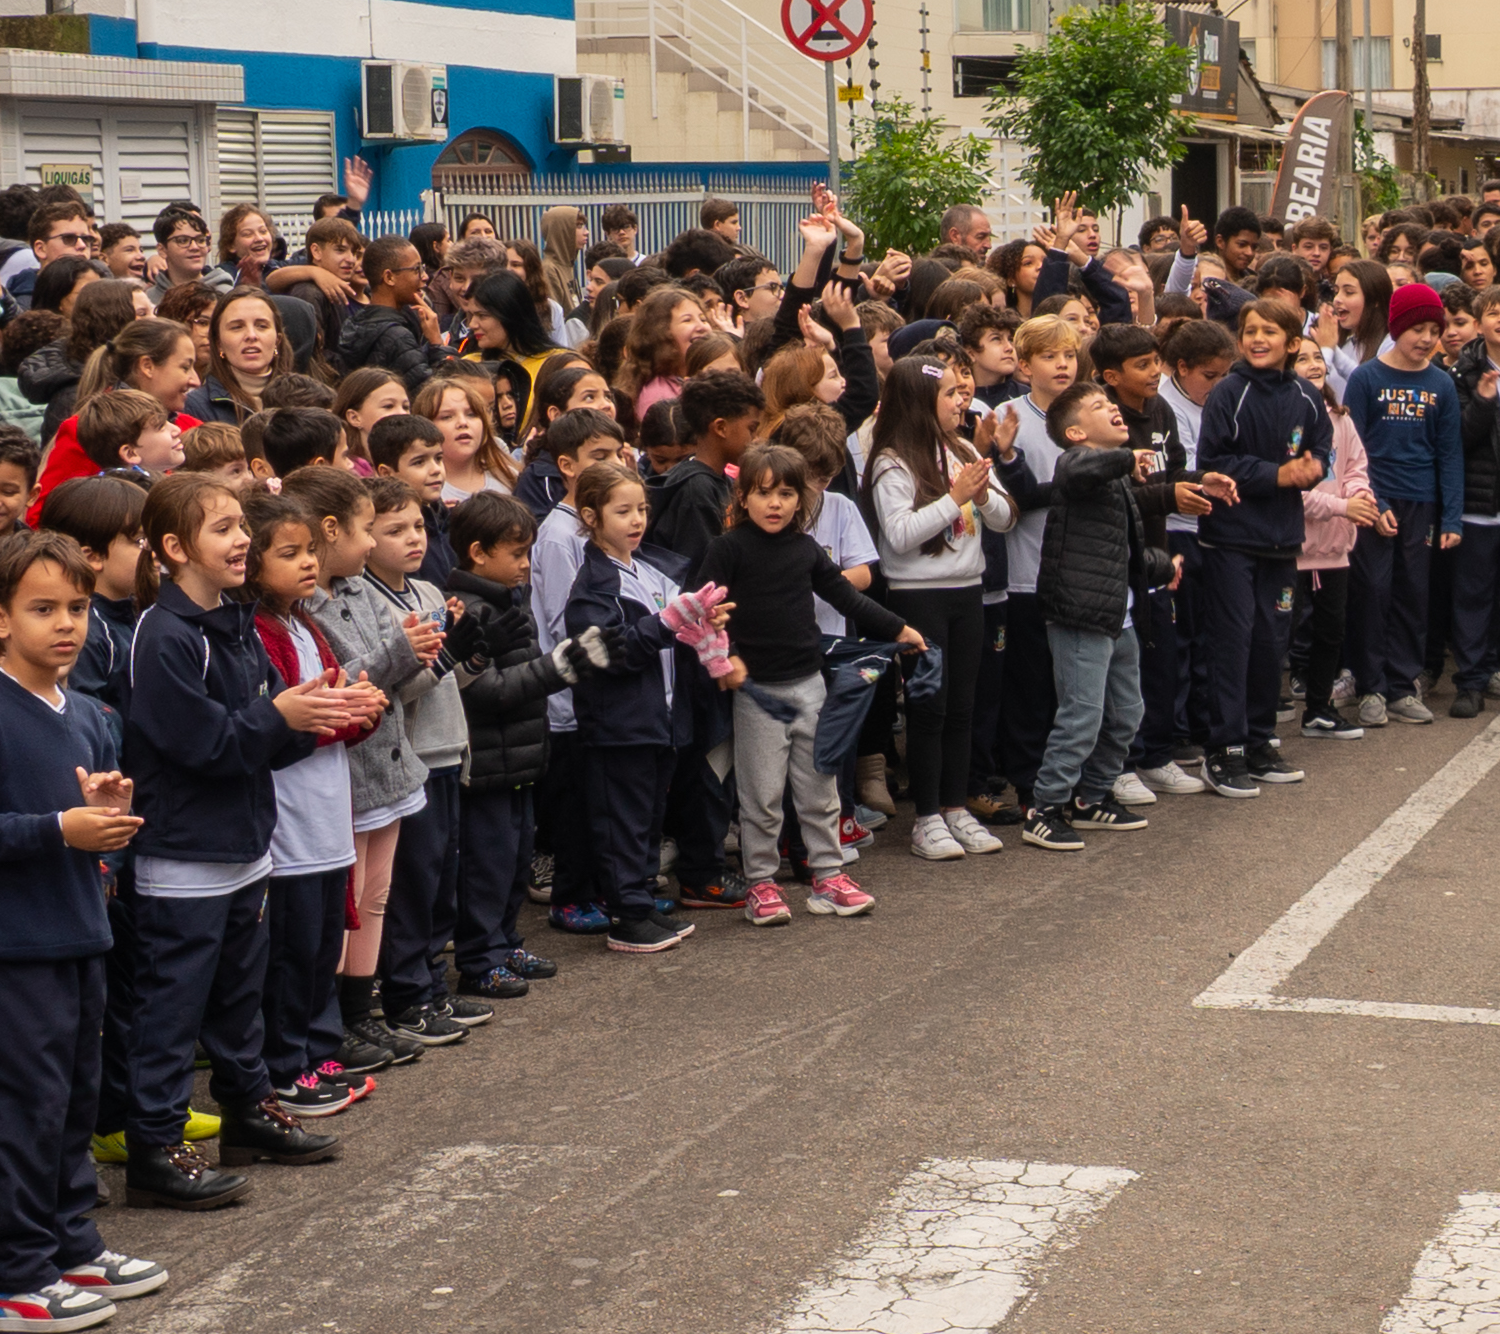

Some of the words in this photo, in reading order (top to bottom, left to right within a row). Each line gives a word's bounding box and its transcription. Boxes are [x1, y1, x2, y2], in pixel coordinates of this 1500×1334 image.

[45, 168, 91, 185] LIQUIGÁS
[1284, 116, 1332, 231] BEARIA
[1378, 388, 1414, 402] JUST
[1420, 391, 1438, 406] BE
[1388, 402, 1426, 417] NICE
